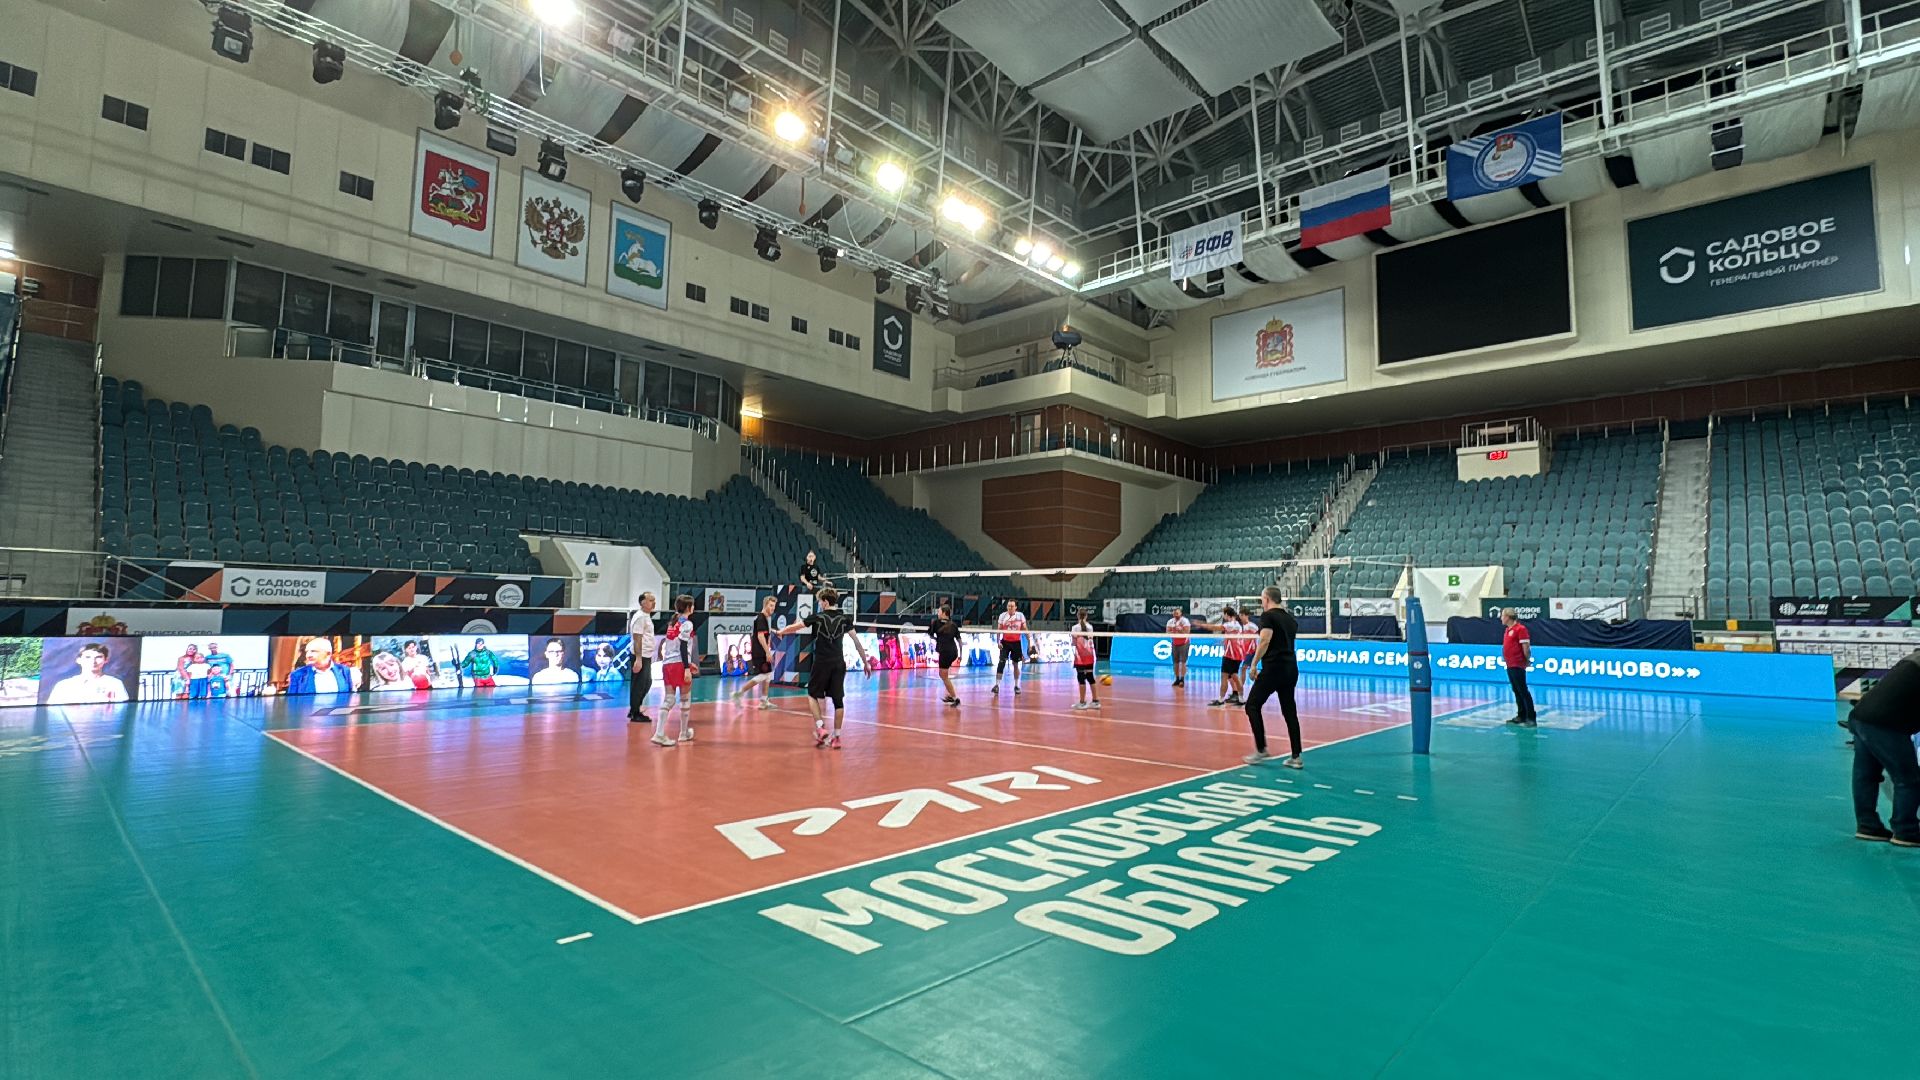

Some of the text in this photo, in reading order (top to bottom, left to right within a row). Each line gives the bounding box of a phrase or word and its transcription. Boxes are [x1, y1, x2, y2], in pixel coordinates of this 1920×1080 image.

[1194, 230, 1234, 256] ВФВ
[1706, 217, 1836, 256] САДОВОЕ
[1708, 239, 1821, 274] КОЛЬЦО
[1709, 255, 1839, 287] ГЕНЕРАЛЬНЫЙ ПАРТНЕР
[256, 578, 317, 589] САДОВОЕ
[256, 588, 310, 598] КОЛЬЦО
[729, 624, 752, 632] САДО
[1296, 649, 1370, 665] БОЛЬНАЯ
[758, 782, 1302, 955] МОСКОВСКАЯ
[1014, 815, 1383, 956] ОБЛАСТЬ
